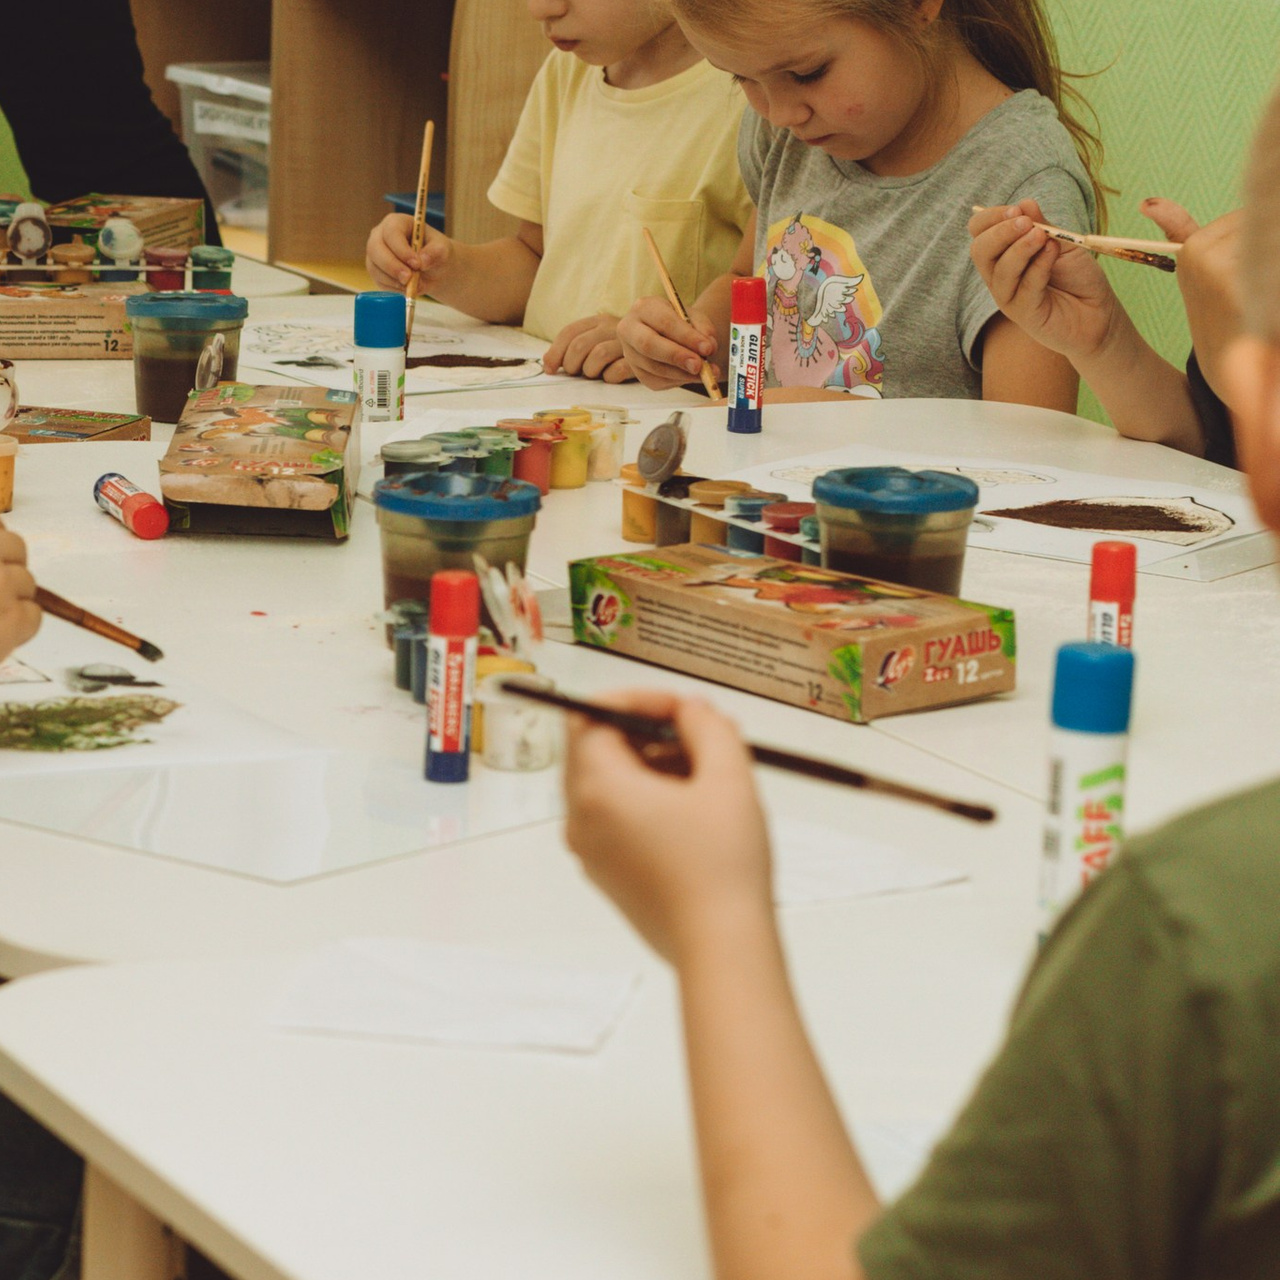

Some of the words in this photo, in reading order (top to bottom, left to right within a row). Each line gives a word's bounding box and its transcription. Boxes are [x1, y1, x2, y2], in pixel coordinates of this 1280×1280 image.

[102, 339, 119, 352] 12
[748, 334, 758, 363] GLUE
[738, 377, 746, 399] SUPER
[746, 366, 757, 398] STICK
[271, 467, 296, 475] 12
[924, 628, 1002, 666] ГУАШЬ
[956, 659, 979, 685] 12
[807, 680, 823, 702] 12
